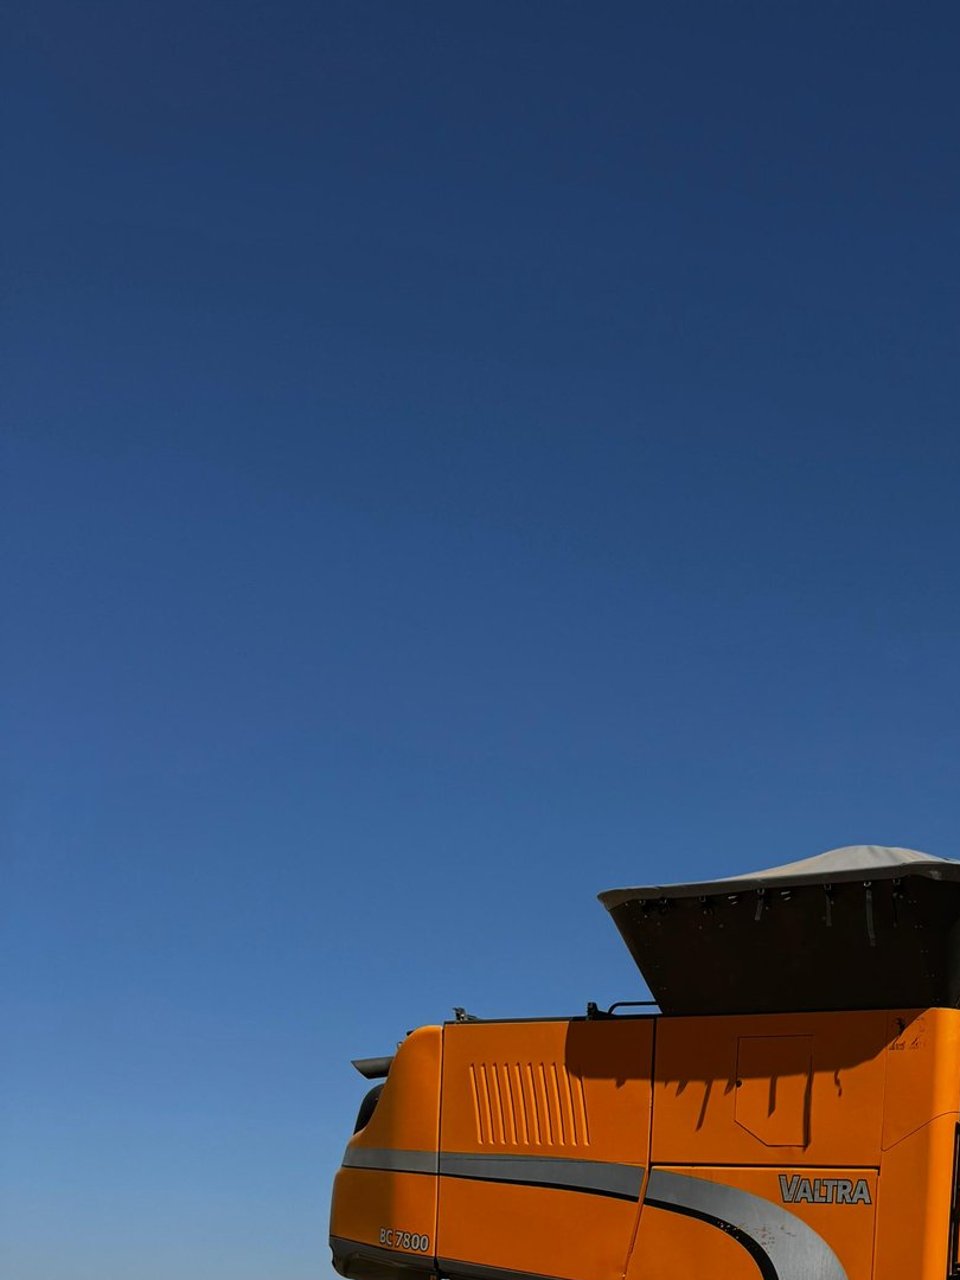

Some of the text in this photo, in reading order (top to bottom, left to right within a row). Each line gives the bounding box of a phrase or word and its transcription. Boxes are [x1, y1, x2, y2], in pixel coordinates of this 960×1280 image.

[778, 1174, 872, 1205] VALTRA
[379, 1227, 430, 1252] BC 7800
